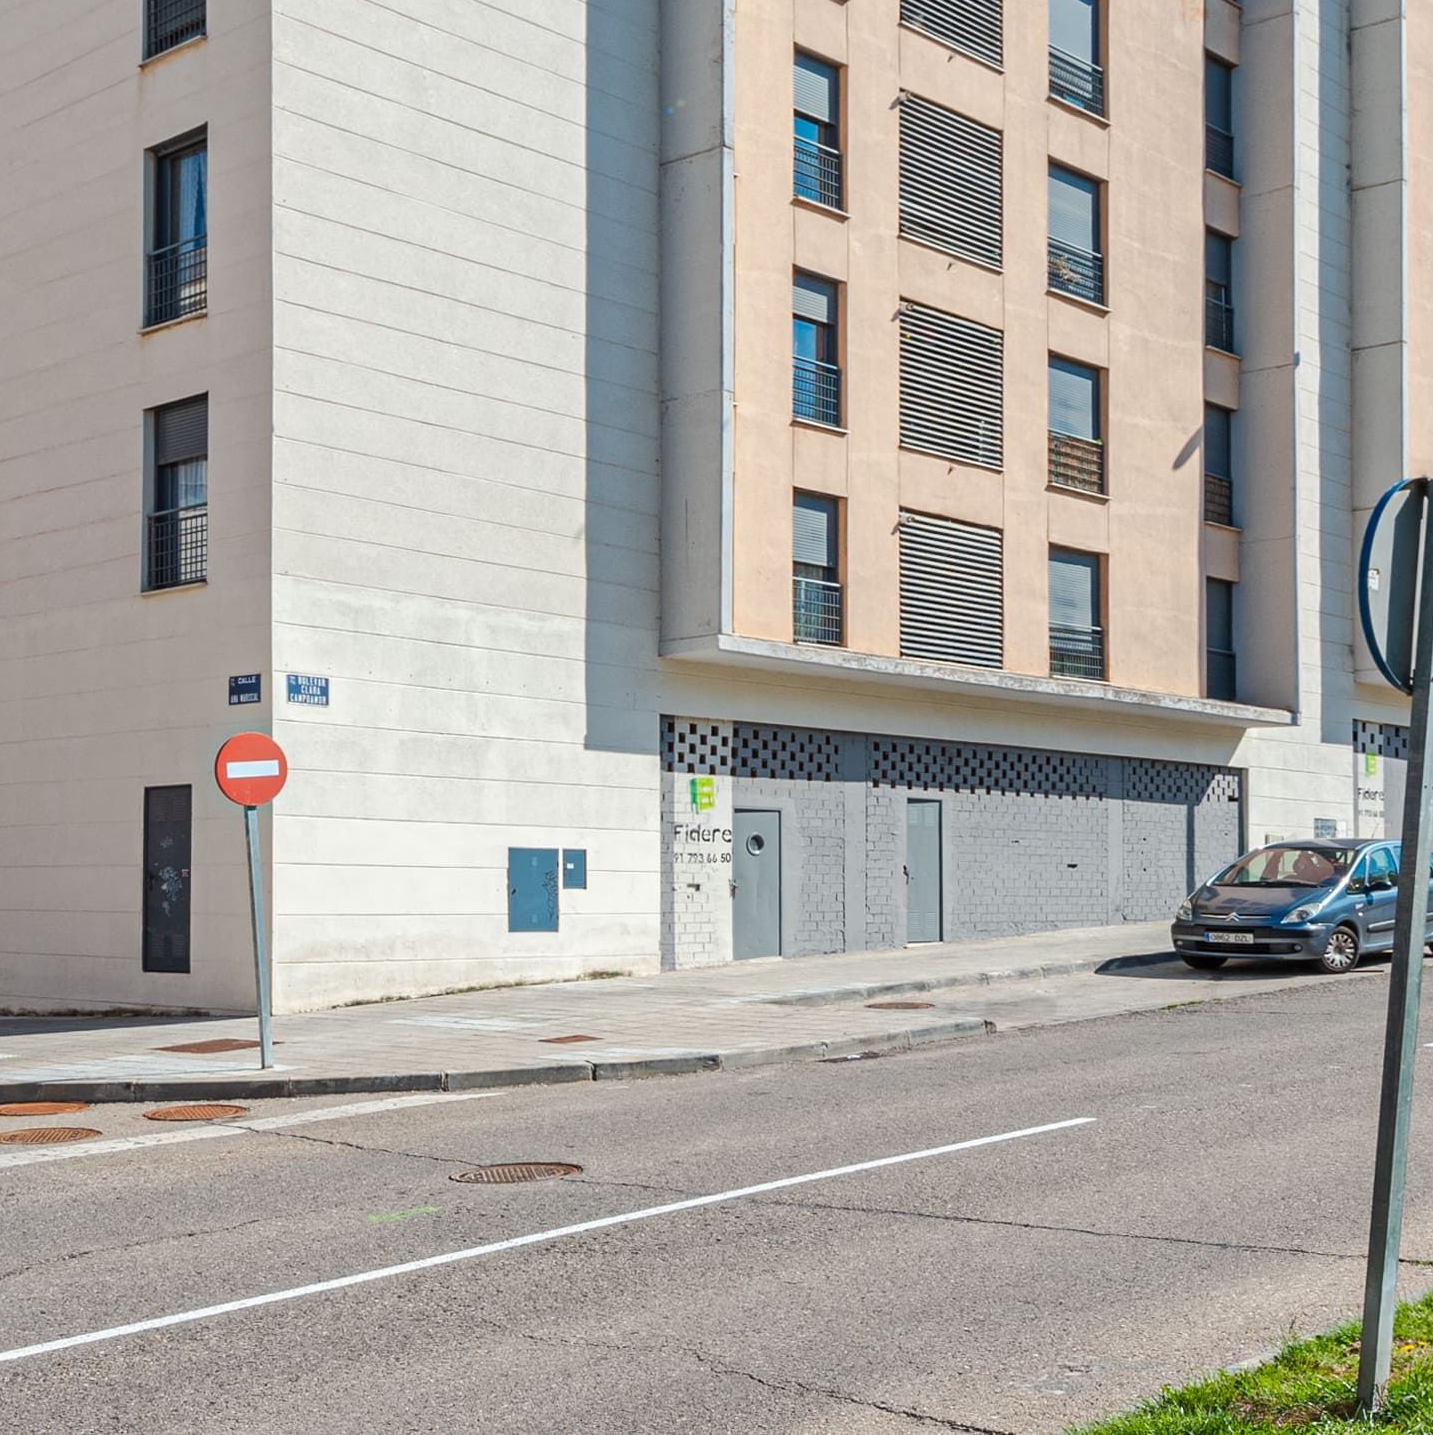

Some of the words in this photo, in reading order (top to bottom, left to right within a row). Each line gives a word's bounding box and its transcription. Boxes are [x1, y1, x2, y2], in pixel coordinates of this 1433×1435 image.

[237, 676, 256, 684] CALLE
[300, 685, 321, 695] CLARA
[289, 693, 327, 705] CAMPOAMOR
[673, 823, 732, 843] Fidere
[674, 852, 684, 863] 91
[687, 852, 704, 864] 793
[720, 852, 732, 863] 50
